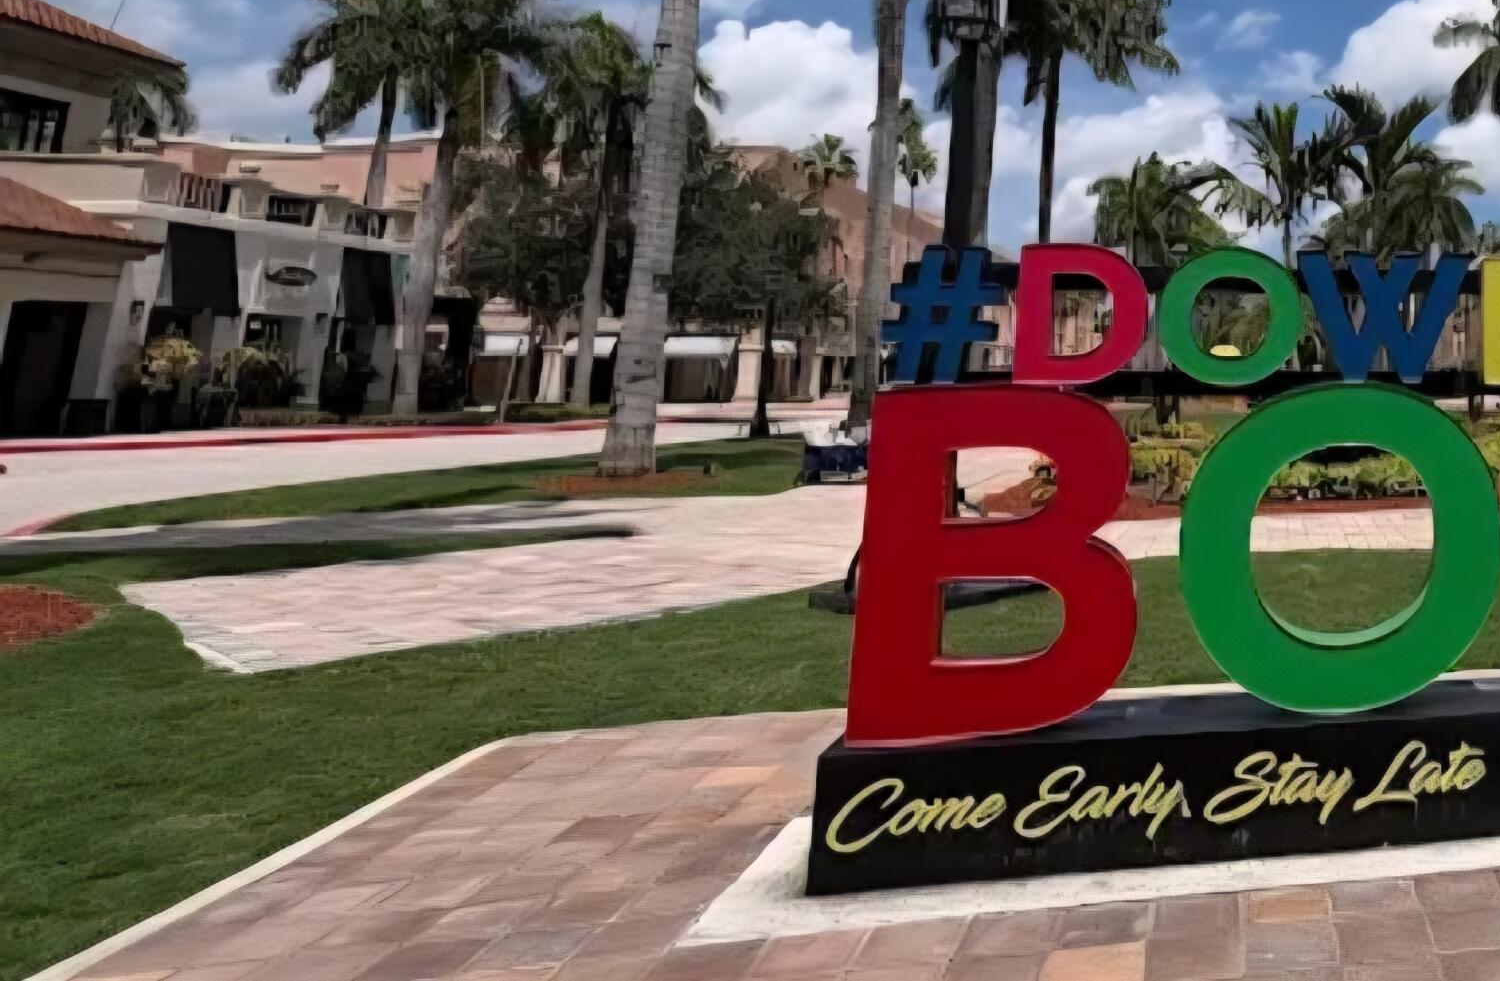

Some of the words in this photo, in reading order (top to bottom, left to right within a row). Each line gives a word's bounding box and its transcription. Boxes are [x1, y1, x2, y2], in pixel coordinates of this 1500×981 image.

[825, 778, 1004, 853] Come
[1203, 750, 1355, 825] Stay
[1353, 739, 1486, 813] Late
